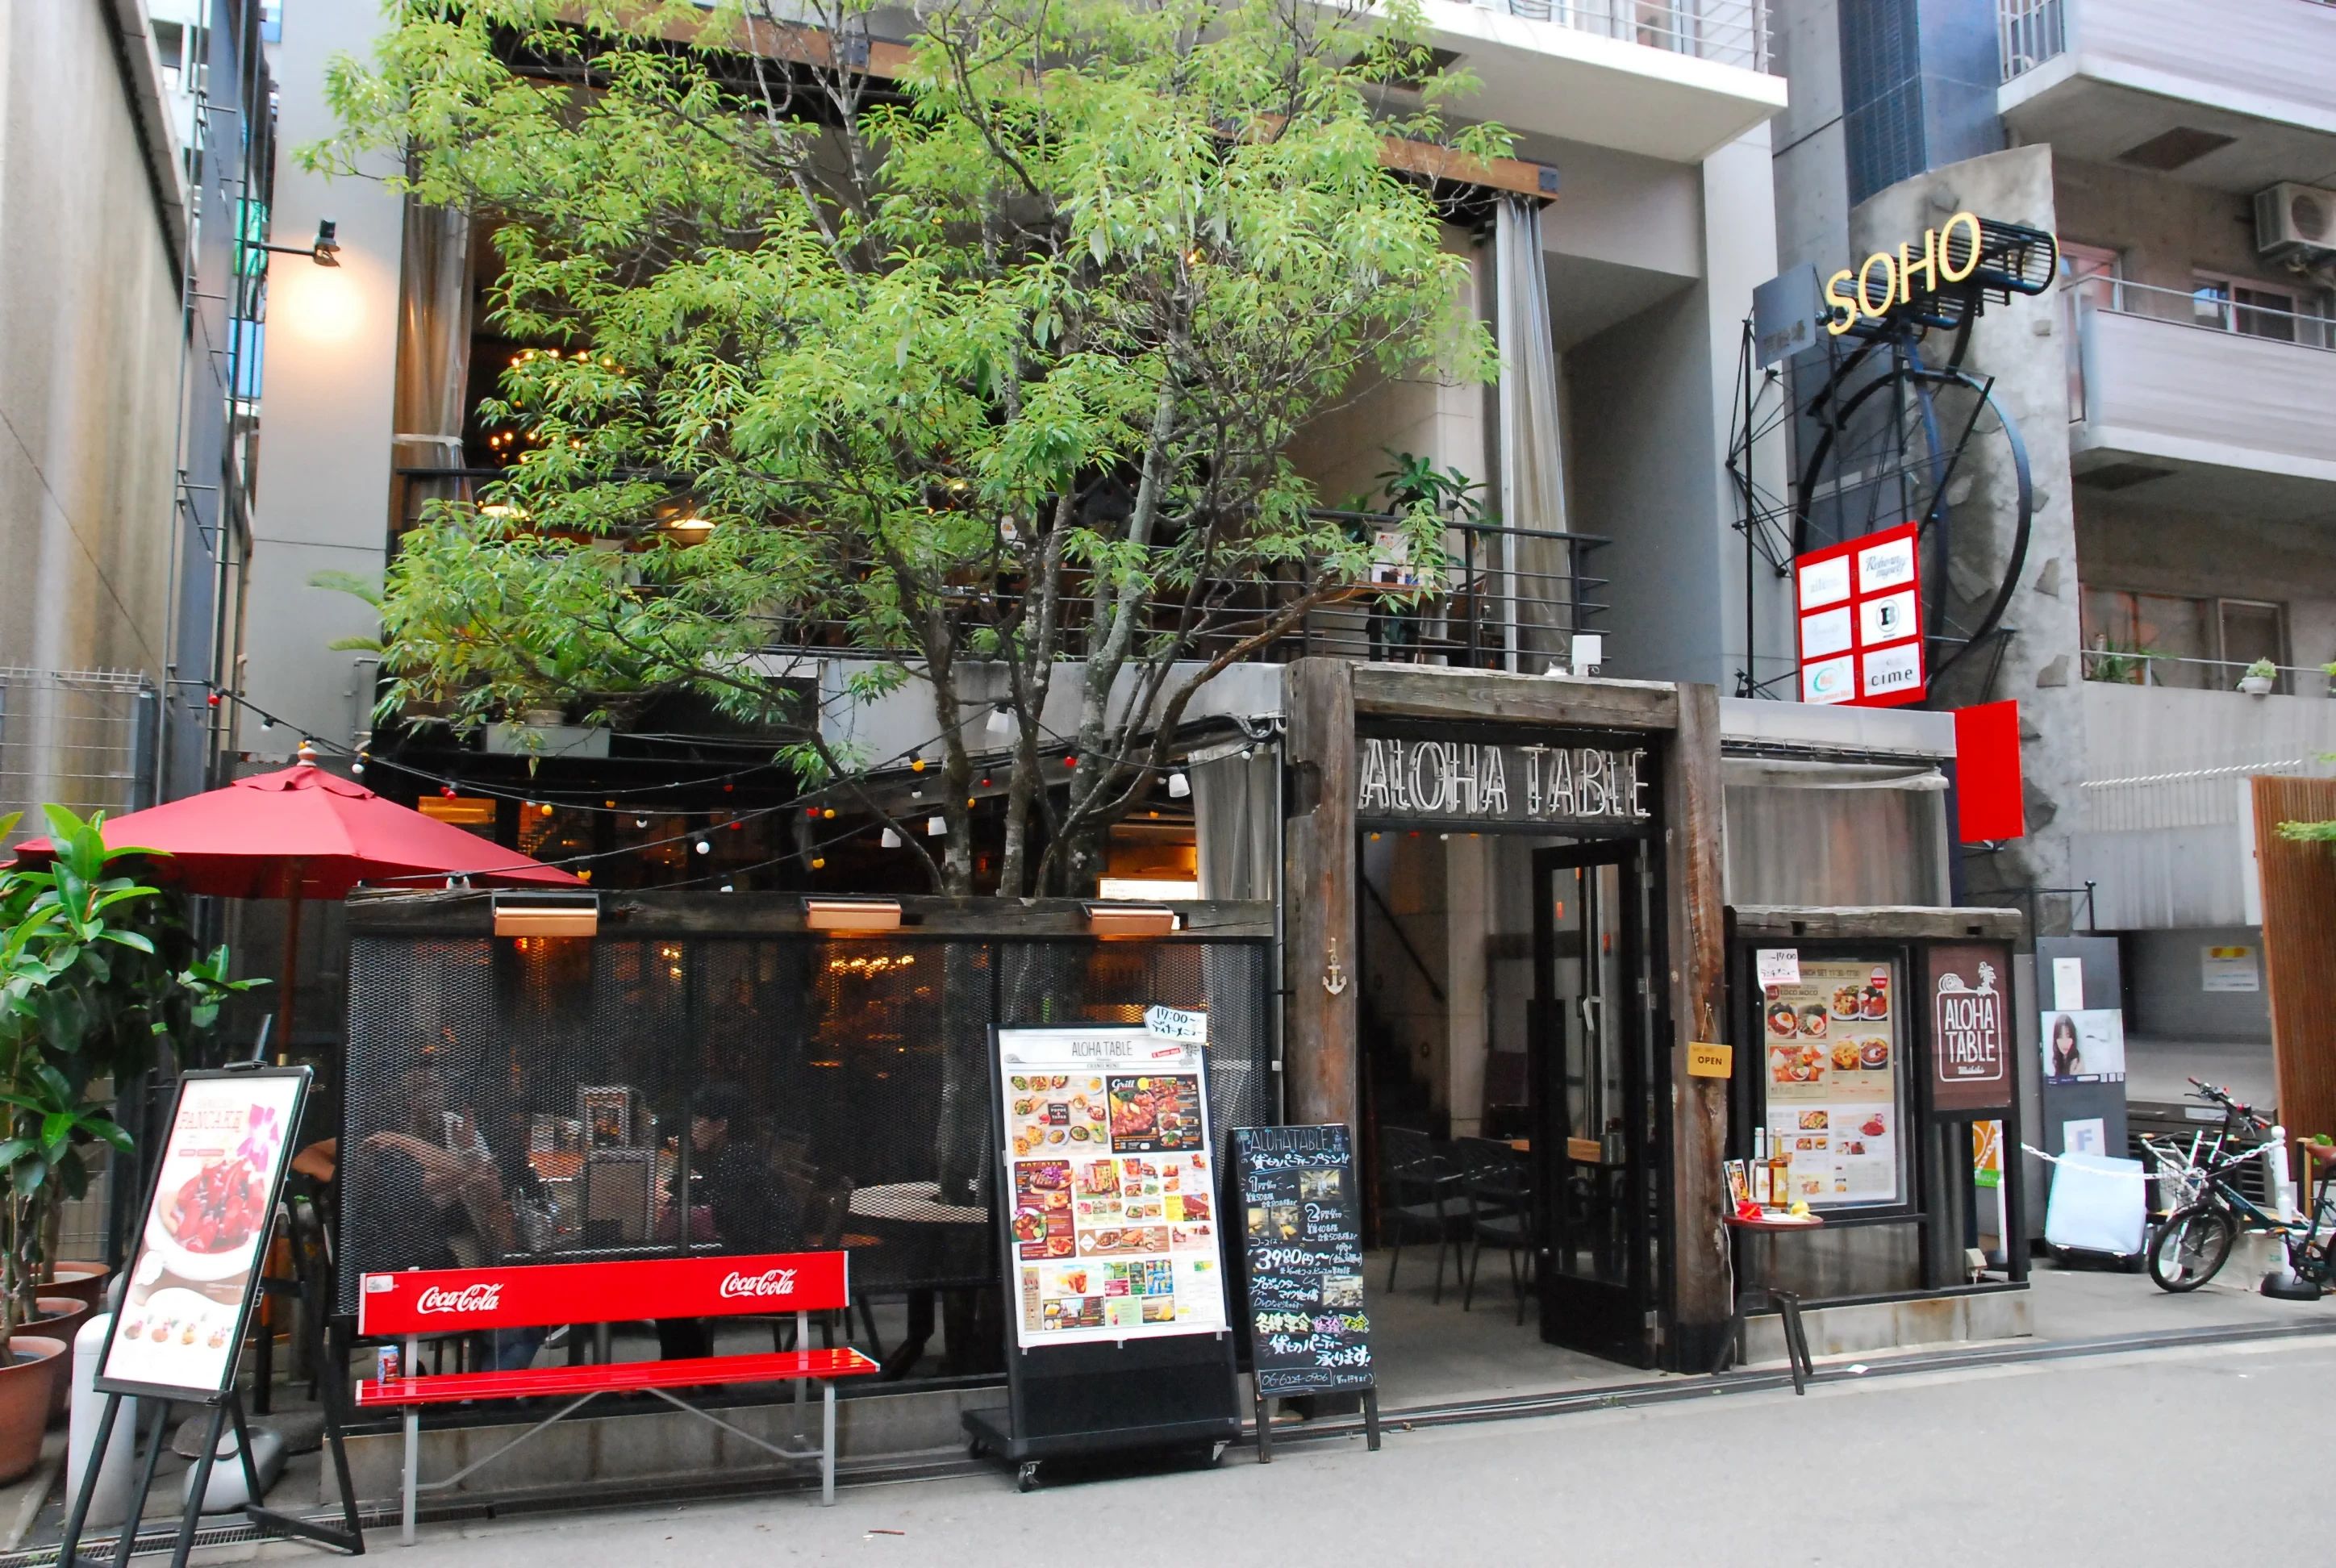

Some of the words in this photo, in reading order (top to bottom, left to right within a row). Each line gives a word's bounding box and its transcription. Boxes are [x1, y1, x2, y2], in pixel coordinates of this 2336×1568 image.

[1825, 211, 1981, 336] SOHO
[1871, 668, 1913, 686] cime
[1358, 738, 1508, 815] ALOHA
[1520, 742, 1652, 818] TABLE
[1945, 998, 1995, 1031] ALOHA
[1072, 1041, 1101, 1057] ALOHA
[1103, 1040, 1133, 1057] TABLE
[1697, 1056, 1722, 1065] OPEN
[1945, 1030, 1996, 1063] TABLE
[1111, 1078, 1135, 1091] Grill
[417, 1283, 504, 1315] Coca-Cola
[720, 1269, 798, 1299] Coca-Cola
[1269, 1333, 1343, 1355] 貸切パーティー
